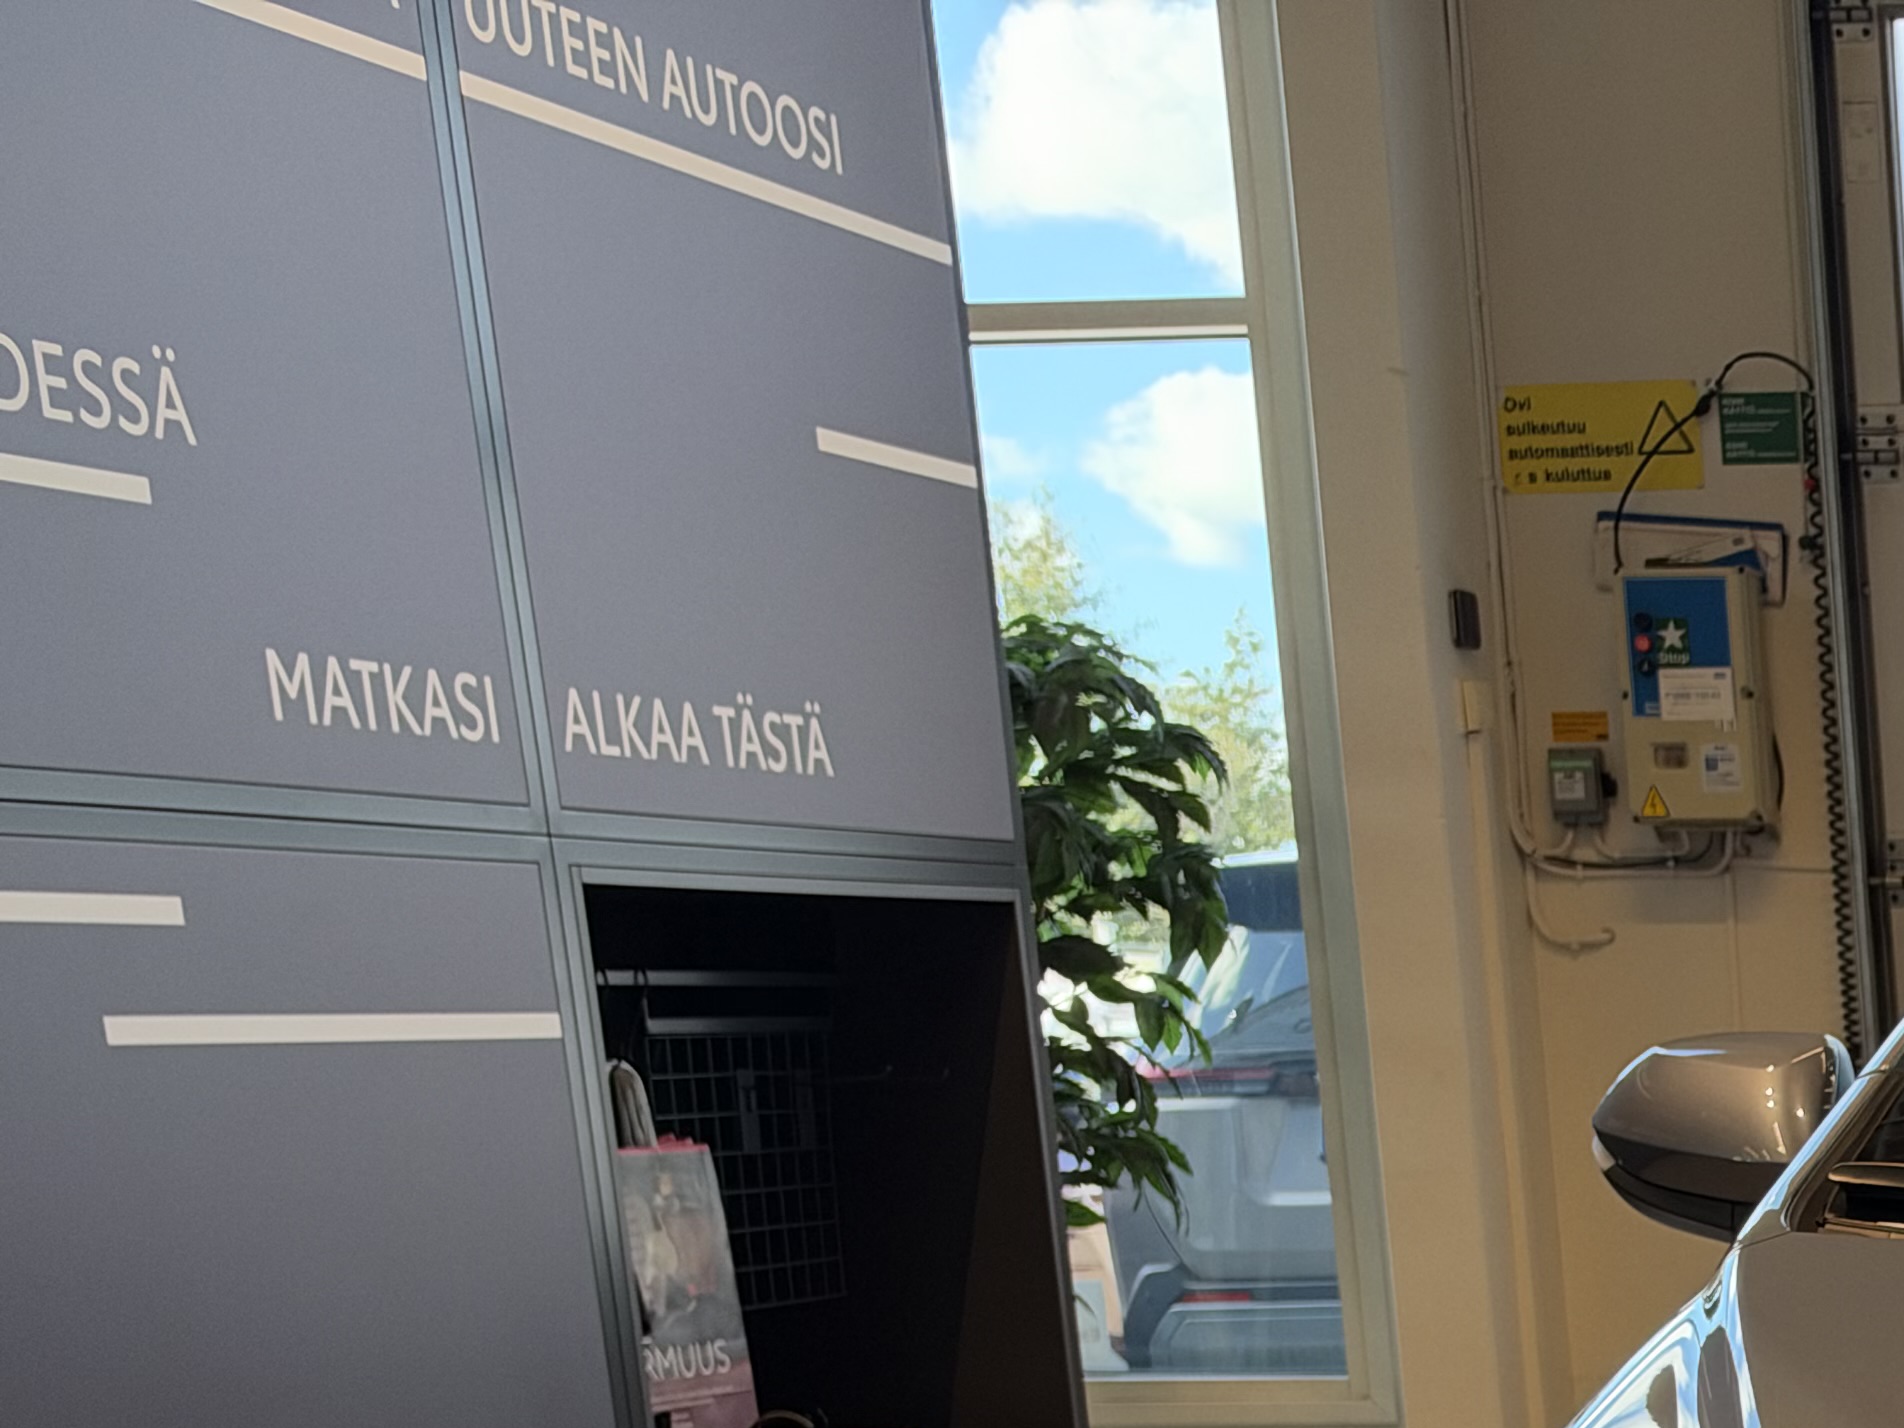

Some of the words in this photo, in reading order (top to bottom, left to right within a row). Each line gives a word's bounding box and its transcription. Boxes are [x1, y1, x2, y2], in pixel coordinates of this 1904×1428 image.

[464, 0, 649, 103] UUTEEN
[662, 48, 844, 175] AUTOOSI
[0, 332, 198, 447] DESSÄ
[265, 647, 500, 744] MATKASI
[564, 687, 710, 767] ALKAA
[712, 692, 836, 778] TÄSTÄ
